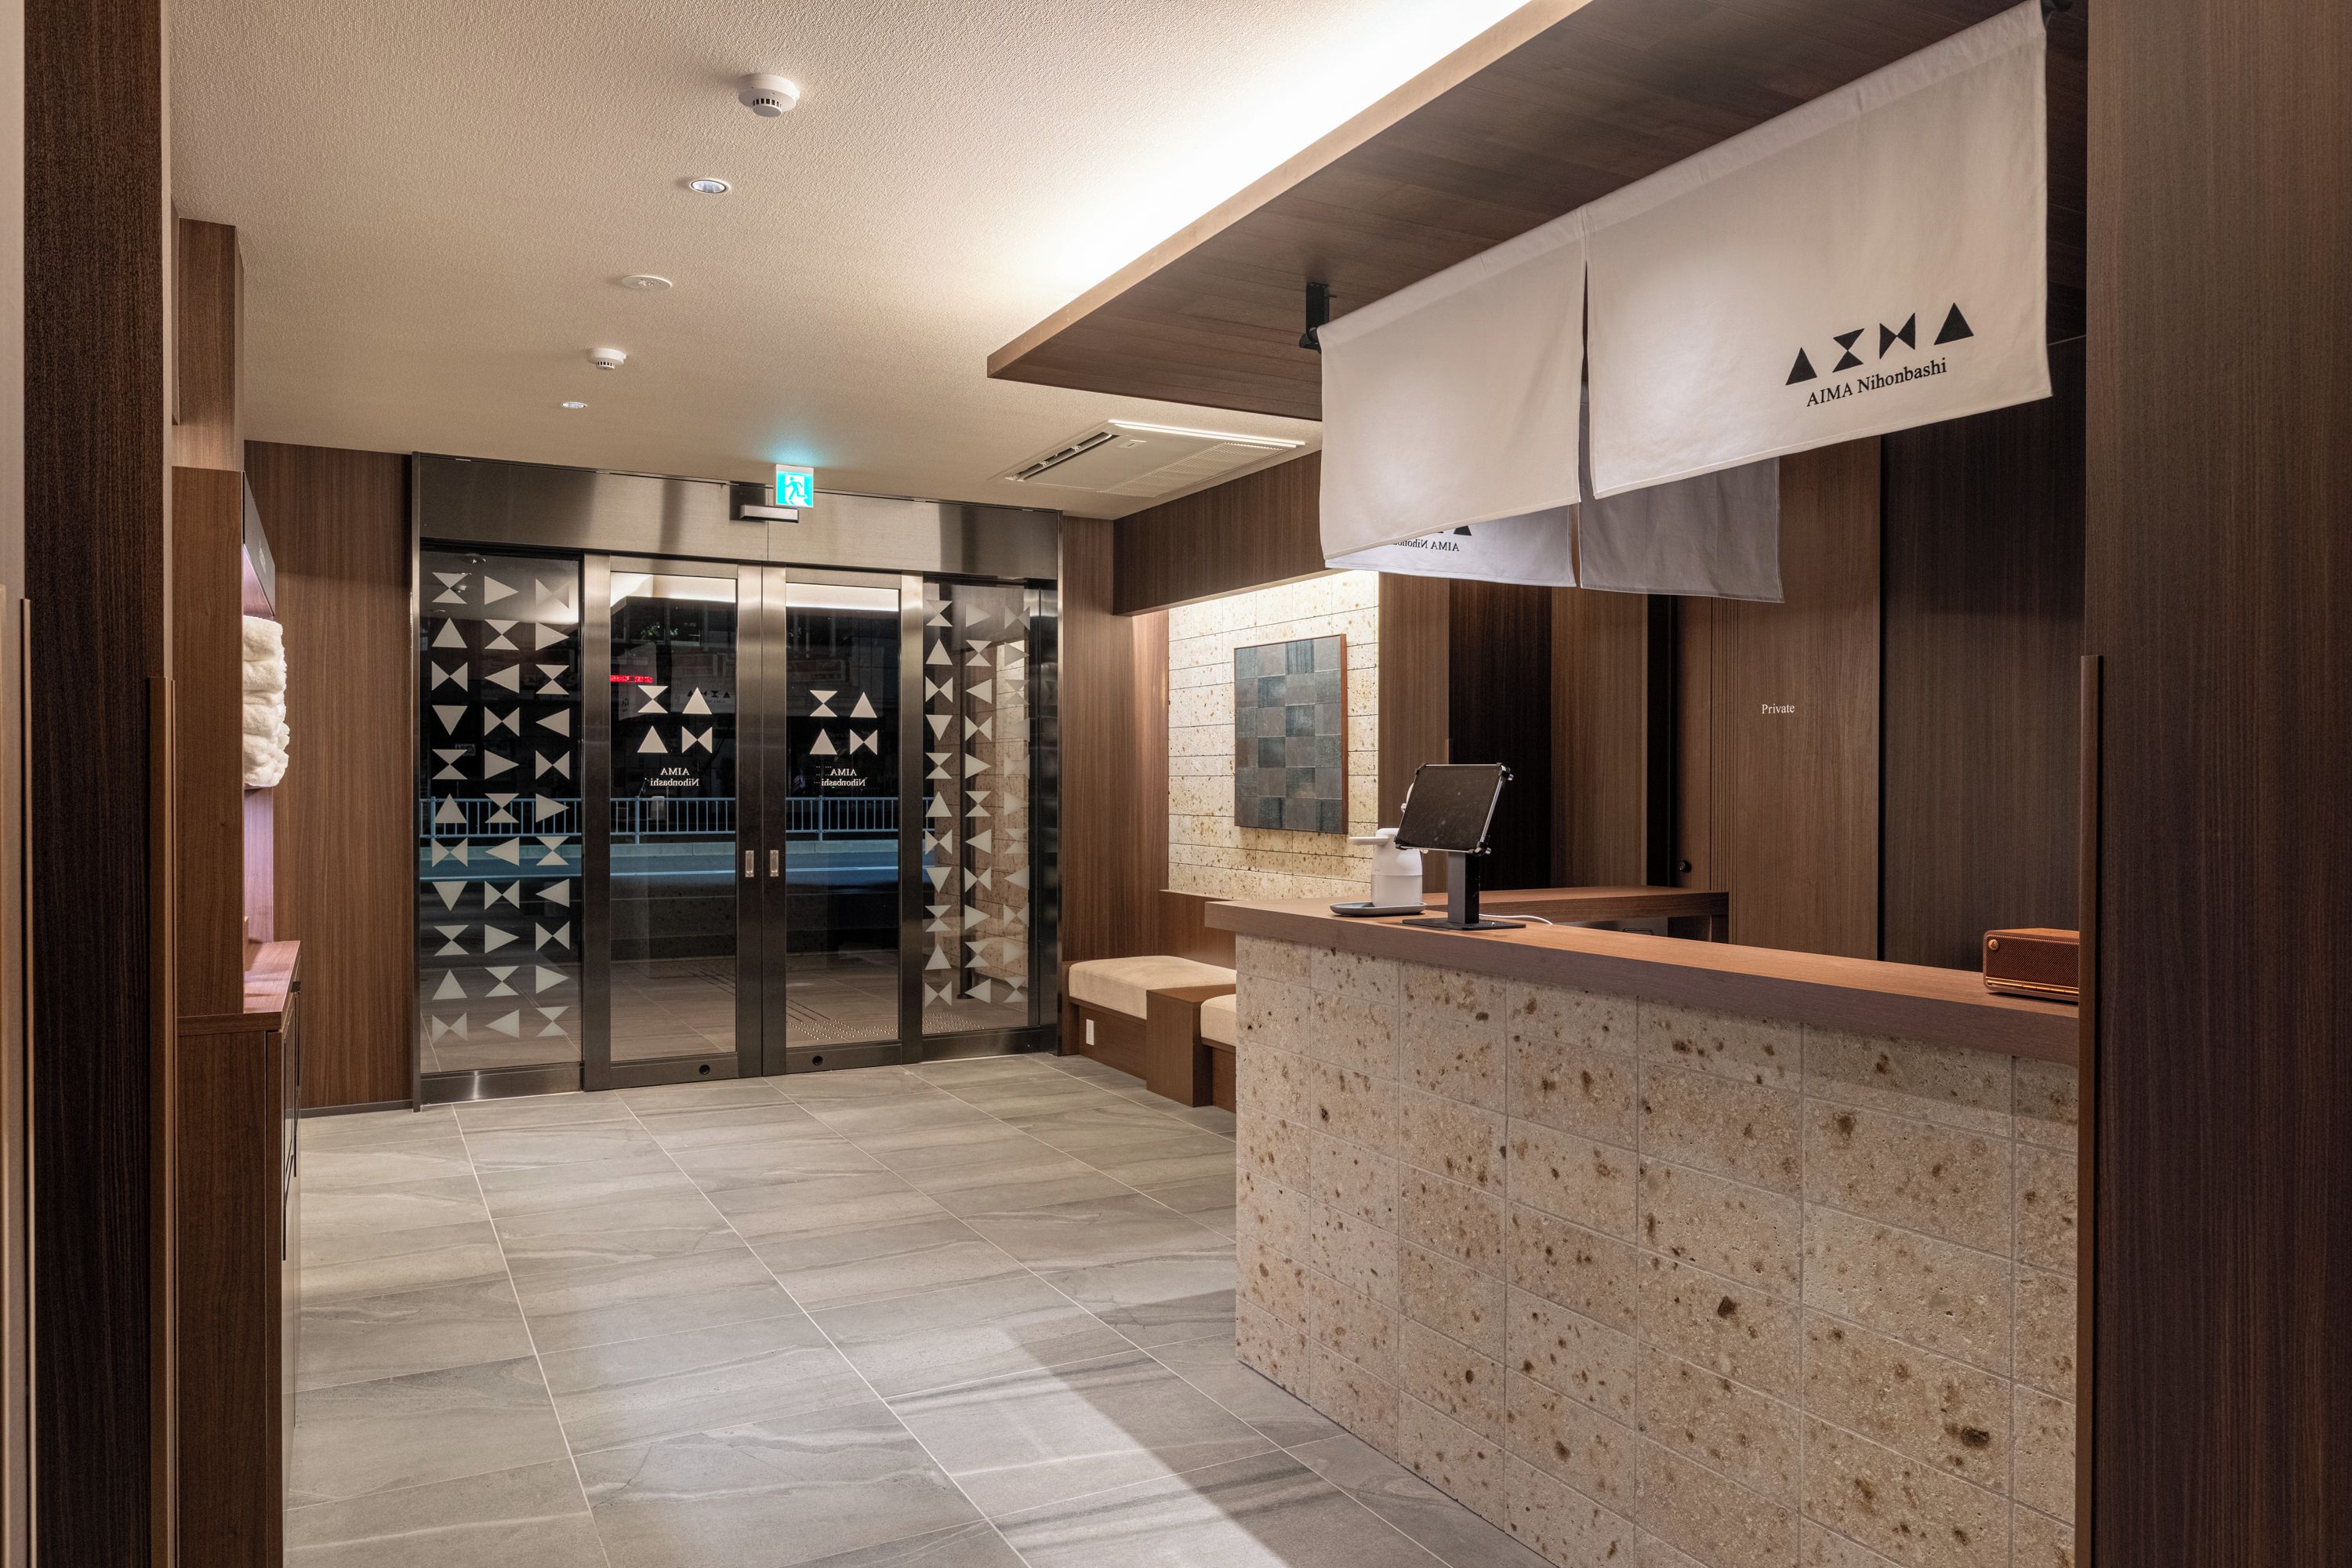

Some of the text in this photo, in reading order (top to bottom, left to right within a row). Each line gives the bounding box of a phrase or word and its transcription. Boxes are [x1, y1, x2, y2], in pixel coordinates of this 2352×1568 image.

[1806, 357, 1947, 407] AIMA Nihonbashi
[1761, 703, 1795, 714] Private
